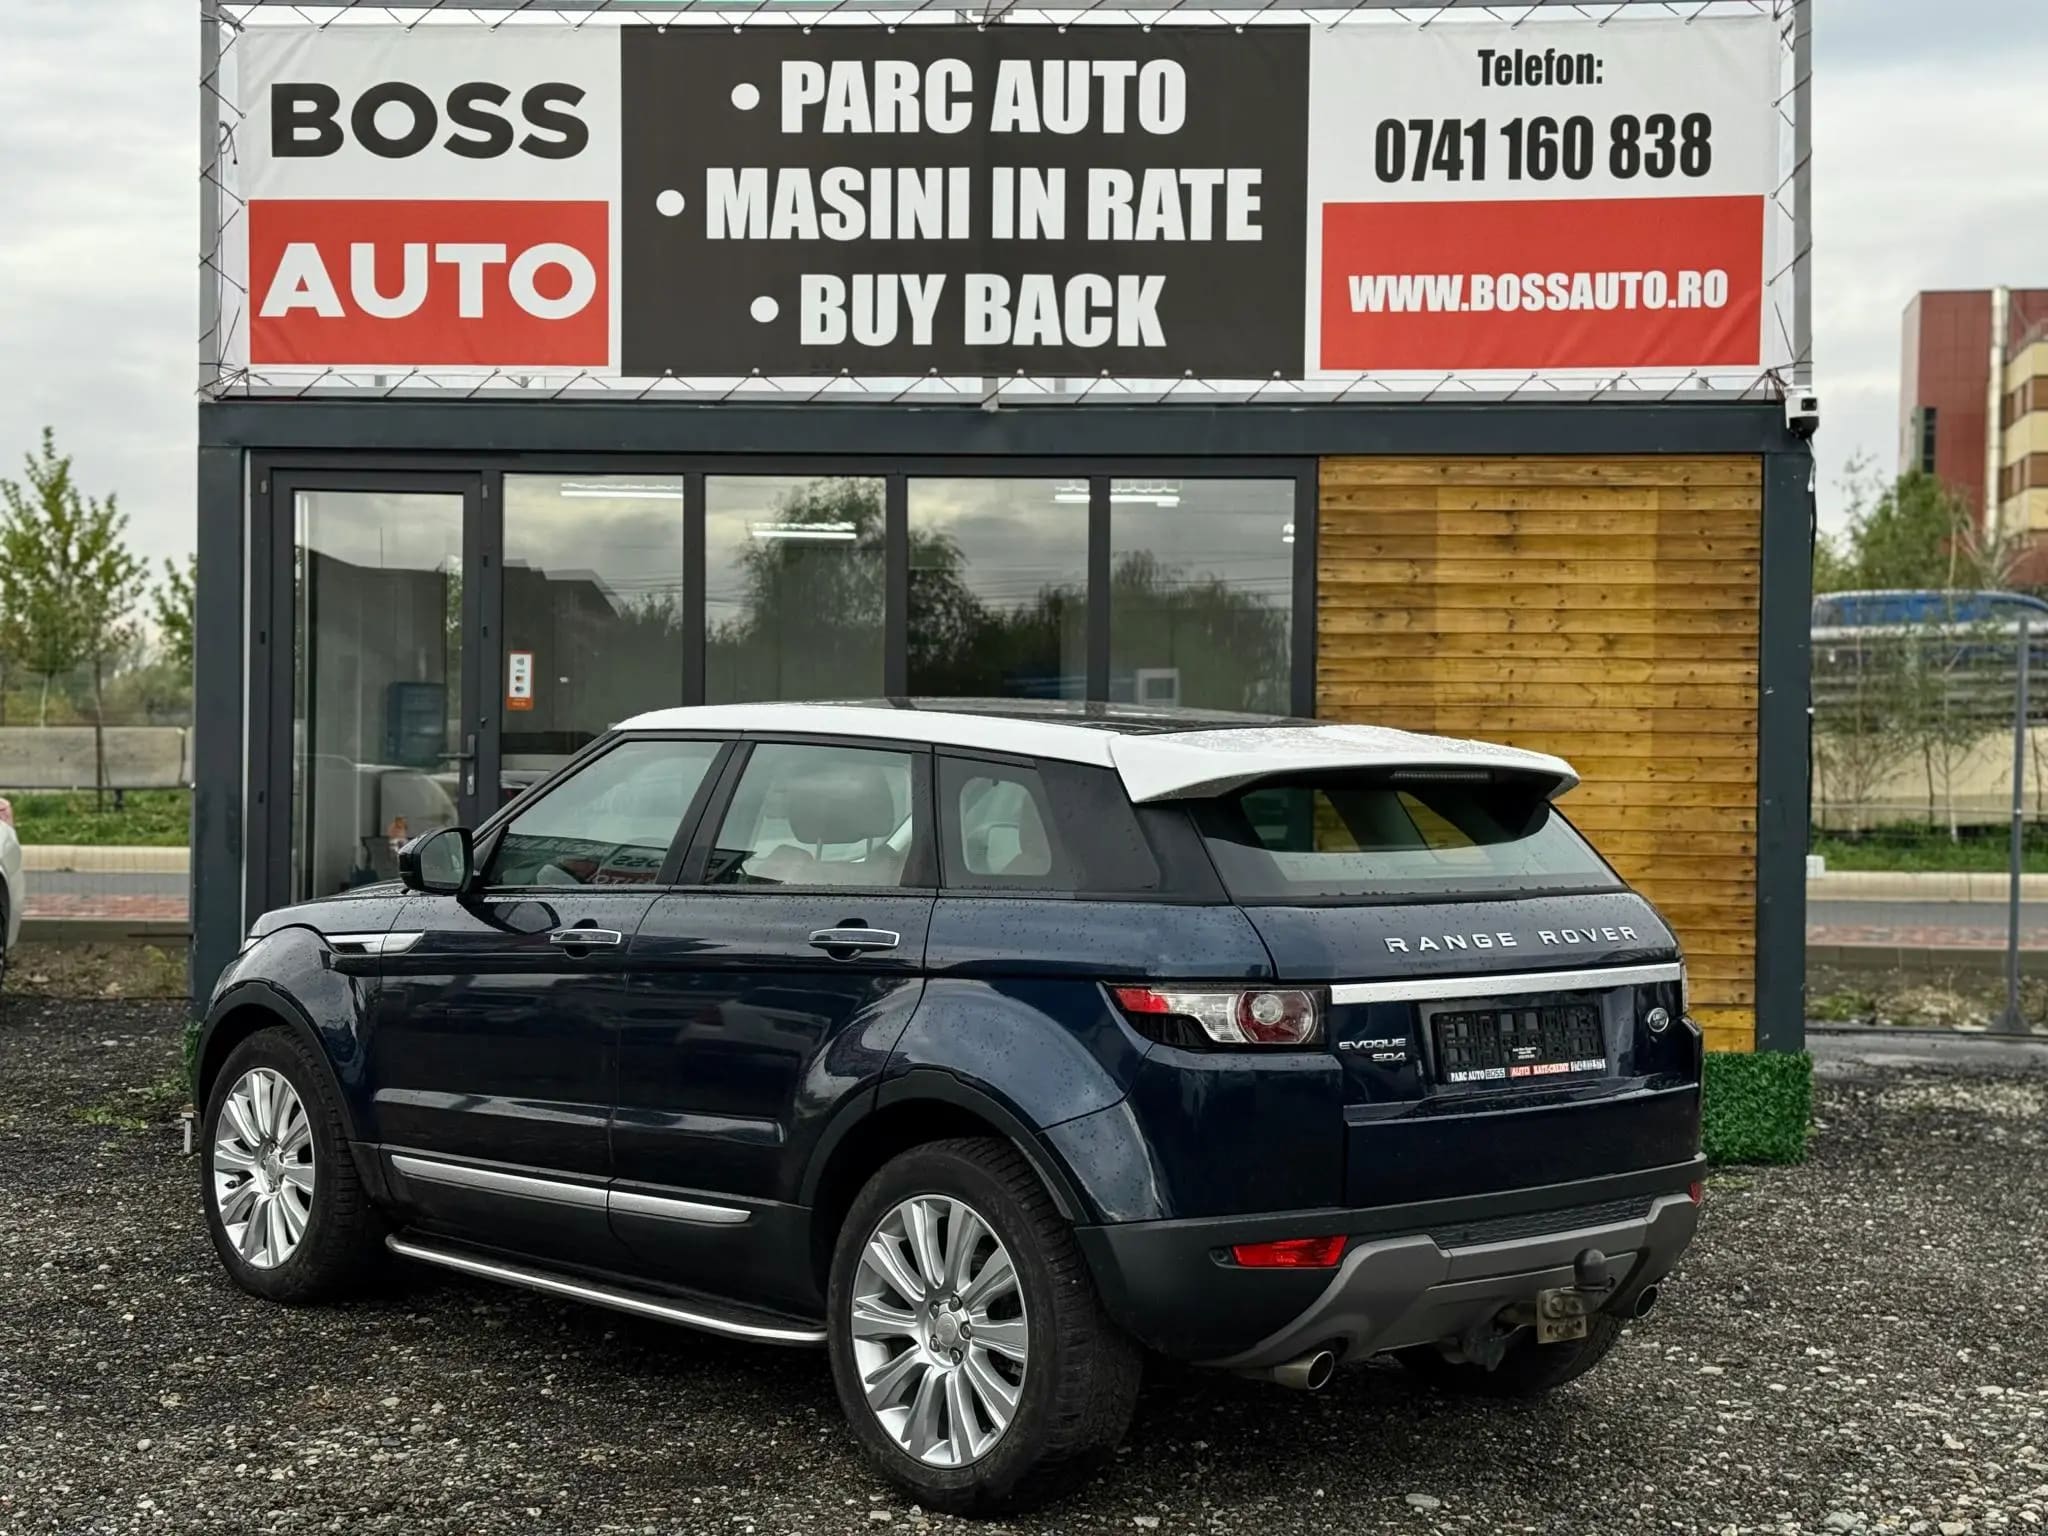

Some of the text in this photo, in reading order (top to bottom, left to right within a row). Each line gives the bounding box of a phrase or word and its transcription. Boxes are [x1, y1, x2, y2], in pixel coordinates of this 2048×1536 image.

[781, 58, 1187, 134] PARC AUTO
[1477, 48, 1603, 88] Telefon:
[271, 81, 589, 160] BOSS
[1375, 112, 1712, 183] 0741 160 838
[706, 166, 1263, 242] MASINI IN RATE
[259, 242, 597, 320] AUTO
[1348, 269, 1728, 313] WWW.BOSSAUTO.RO
[800, 273, 1168, 347] BUY BACK
[1383, 926, 1638, 953] RANGE ROVER
[1338, 1038, 1407, 1050] EVOQUE
[1372, 1052, 1407, 1062] SD4
[1450, 1072, 1468, 1082] PARC
[1468, 1070, 1485, 1081] AUTO
[1486, 1069, 1505, 1079] BOSS
